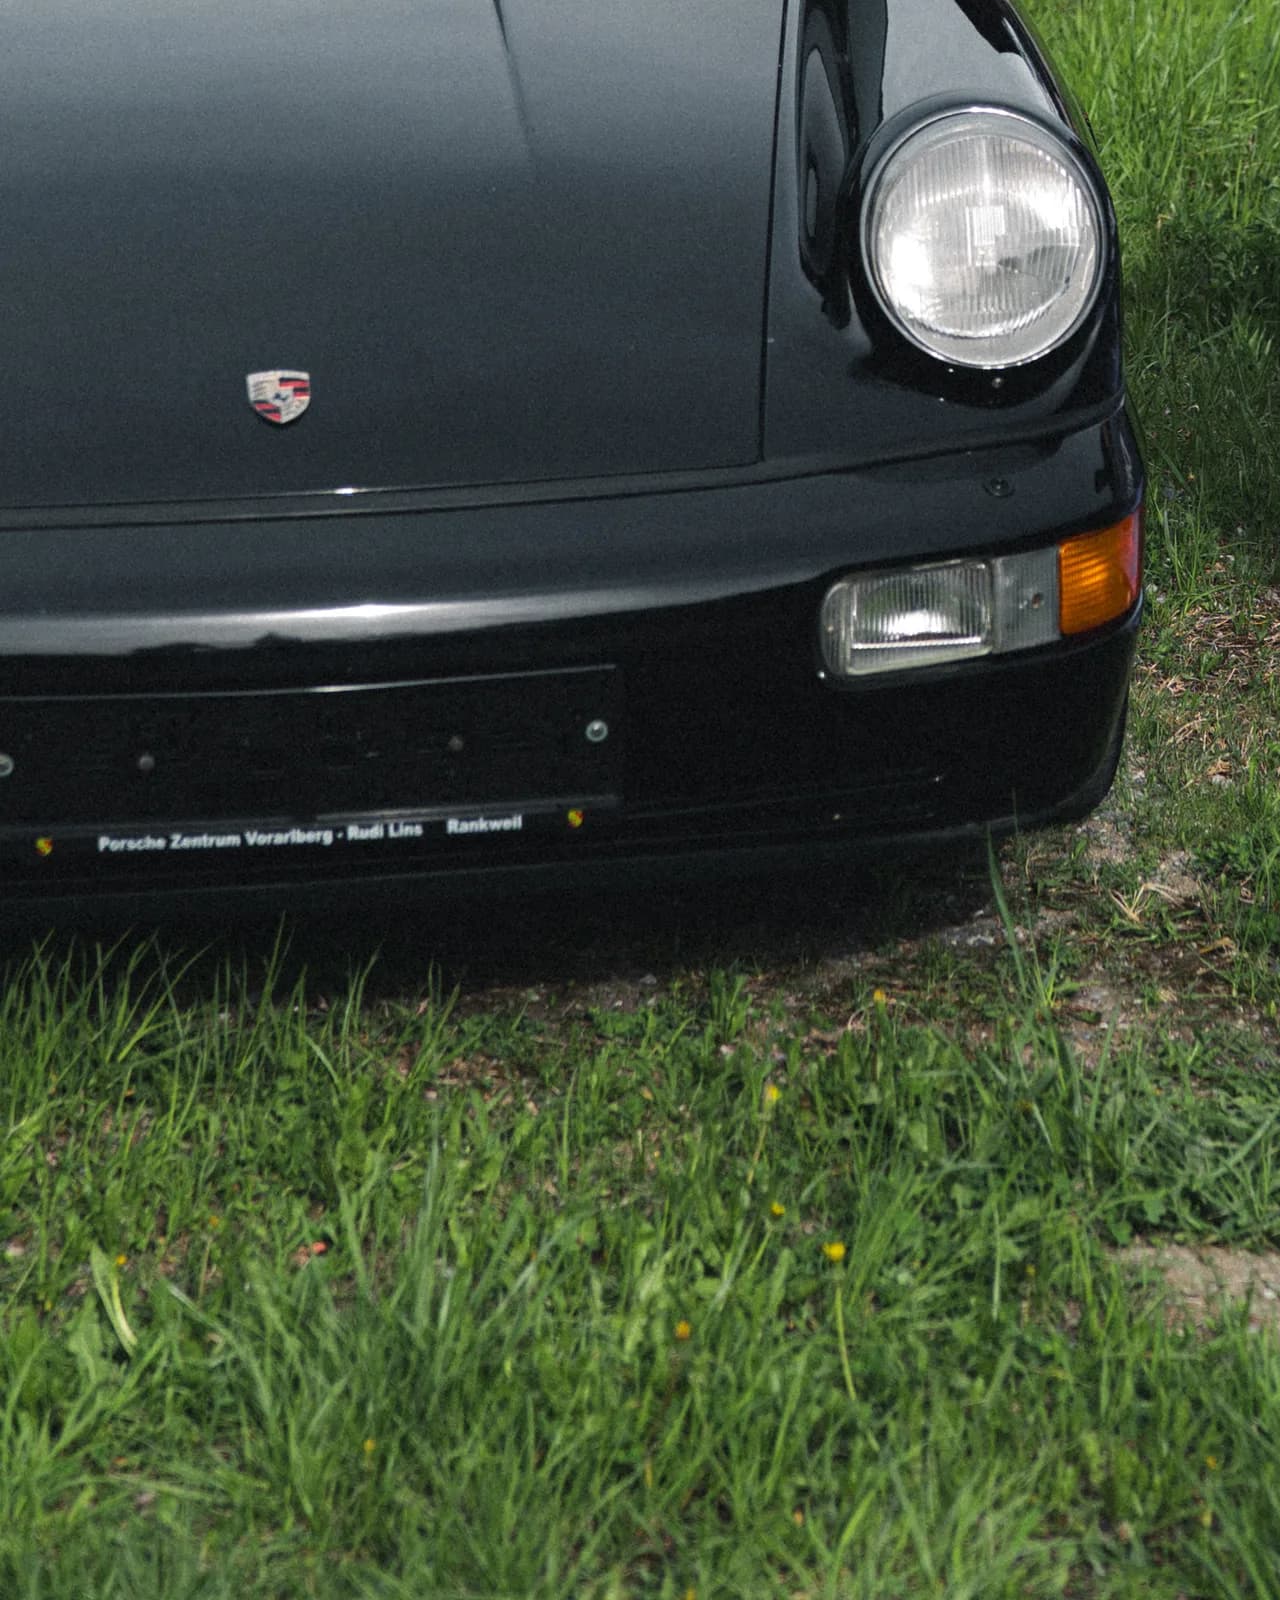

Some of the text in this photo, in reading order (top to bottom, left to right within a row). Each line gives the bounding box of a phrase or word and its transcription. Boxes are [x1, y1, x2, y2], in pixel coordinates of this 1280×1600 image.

[99, 834, 166, 852] Porsche
[169, 832, 241, 849] Zentrum
[244, 828, 333, 846] Vorarlberg
[347, 823, 384, 841] Rudi
[388, 821, 424, 838] Lins
[447, 814, 522, 835] Rankweil
